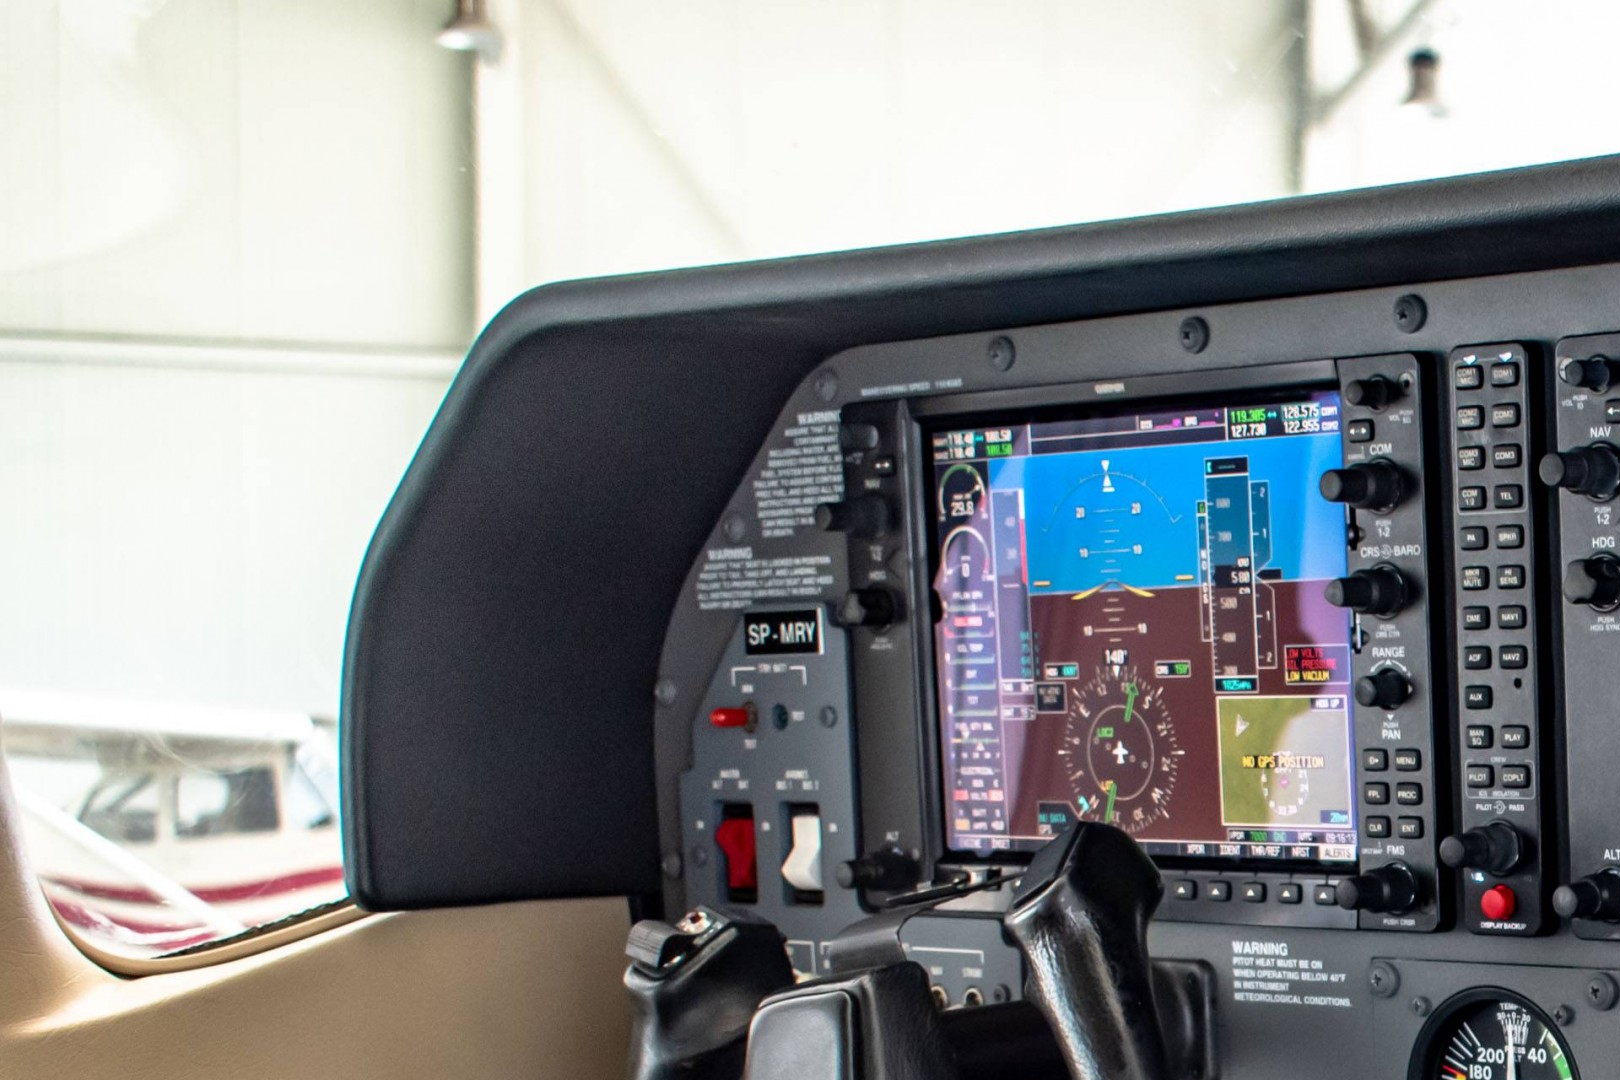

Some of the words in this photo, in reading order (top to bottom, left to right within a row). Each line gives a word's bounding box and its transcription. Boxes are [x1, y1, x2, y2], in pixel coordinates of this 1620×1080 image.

[1284, 418, 1320, 433] 122.955
[1590, 426, 1612, 438] NAV
[1370, 443, 1392, 455] COM
[1500, 492, 1513, 500] TEL
[1592, 536, 1615, 549] HDG
[1361, 546, 1380, 558] CRS
[1393, 544, 1421, 557] BARO
[1372, 647, 1405, 657] RANGE
[1502, 652, 1520, 662] NAV2
[1242, 756, 1254, 767] NO
[1258, 755, 1276, 768] GPS
[1278, 755, 1324, 769] POSITION
[1603, 849, 1620, 860] ALT
[1480, 921, 1501, 929] DISPLAY
[1501, 921, 1526, 930] BACKUP
[1232, 941, 1288, 956] WARNING
[1232, 968, 1256, 978] WHEN
[1257, 969, 1299, 980] OPERATING
[1301, 972, 1328, 981] BELOW
[1477, 1047, 1504, 1064] 200
[1528, 1047, 1547, 1064] 40
[1469, 1064, 1492, 1080] 180
